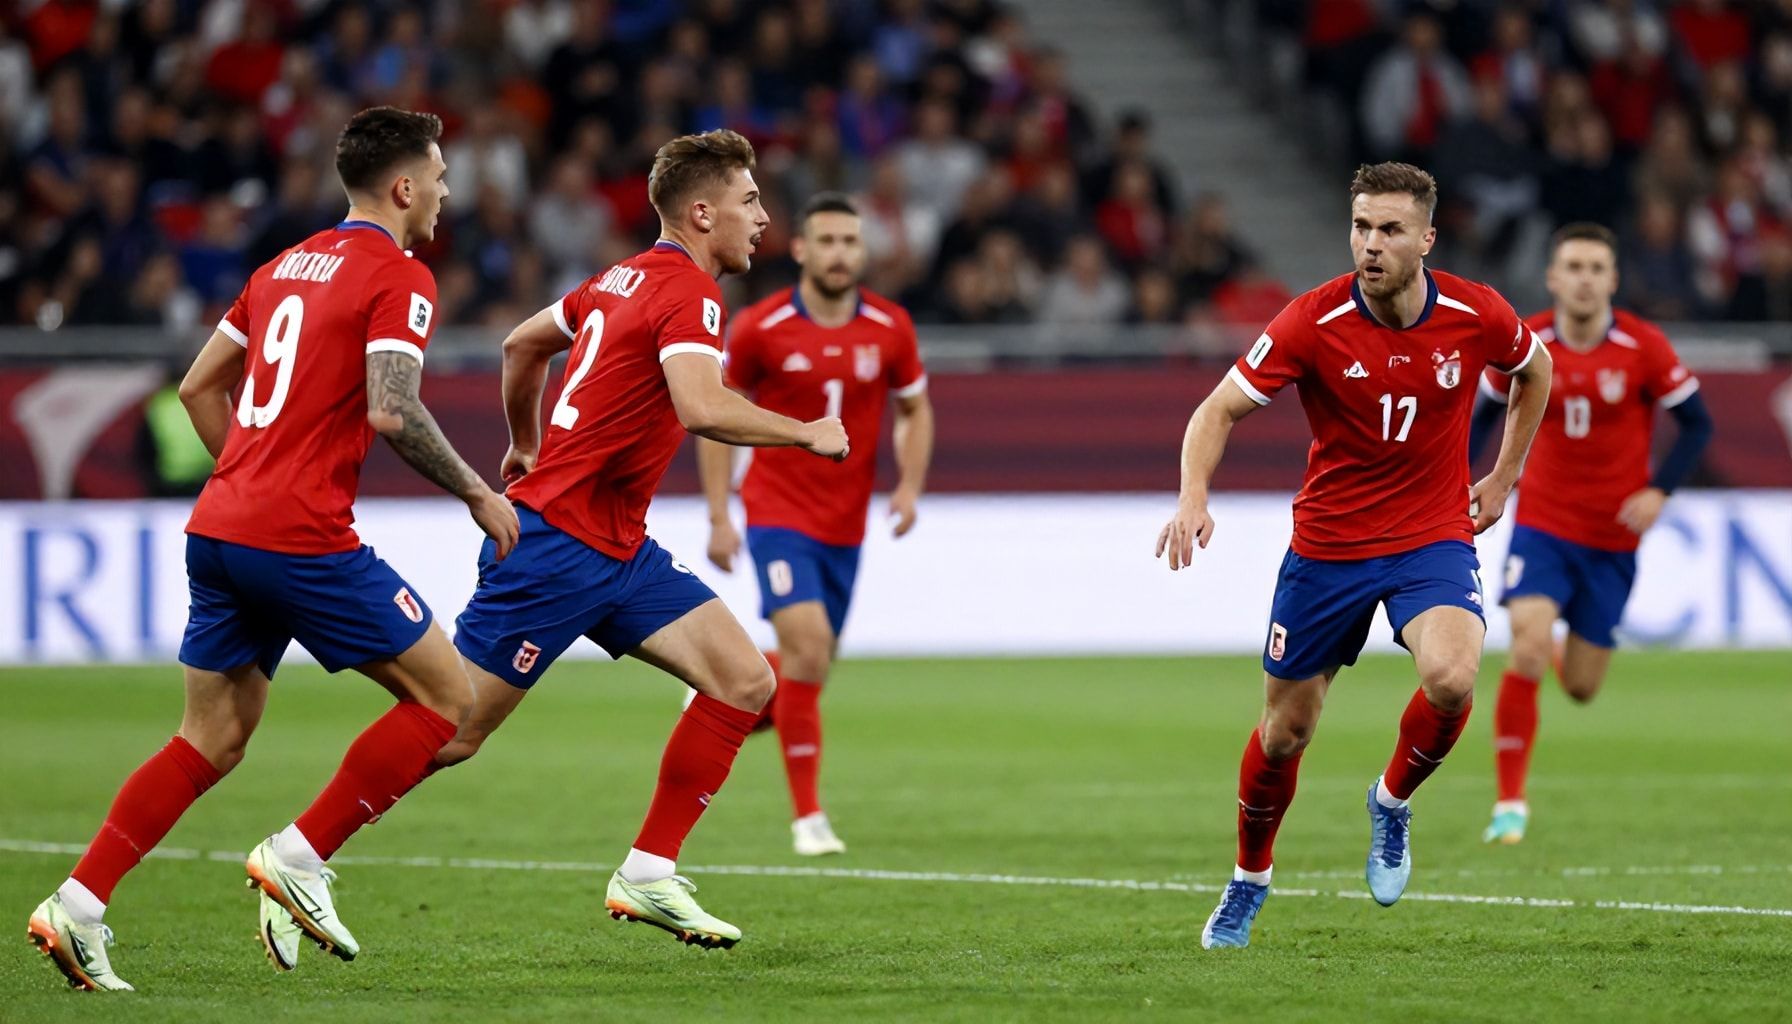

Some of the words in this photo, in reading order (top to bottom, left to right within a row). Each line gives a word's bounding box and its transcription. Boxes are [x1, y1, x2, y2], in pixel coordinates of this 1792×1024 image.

[237, 295, 304, 428] 9
[550, 308, 605, 431] 2
[1378, 393, 1418, 443] 17
